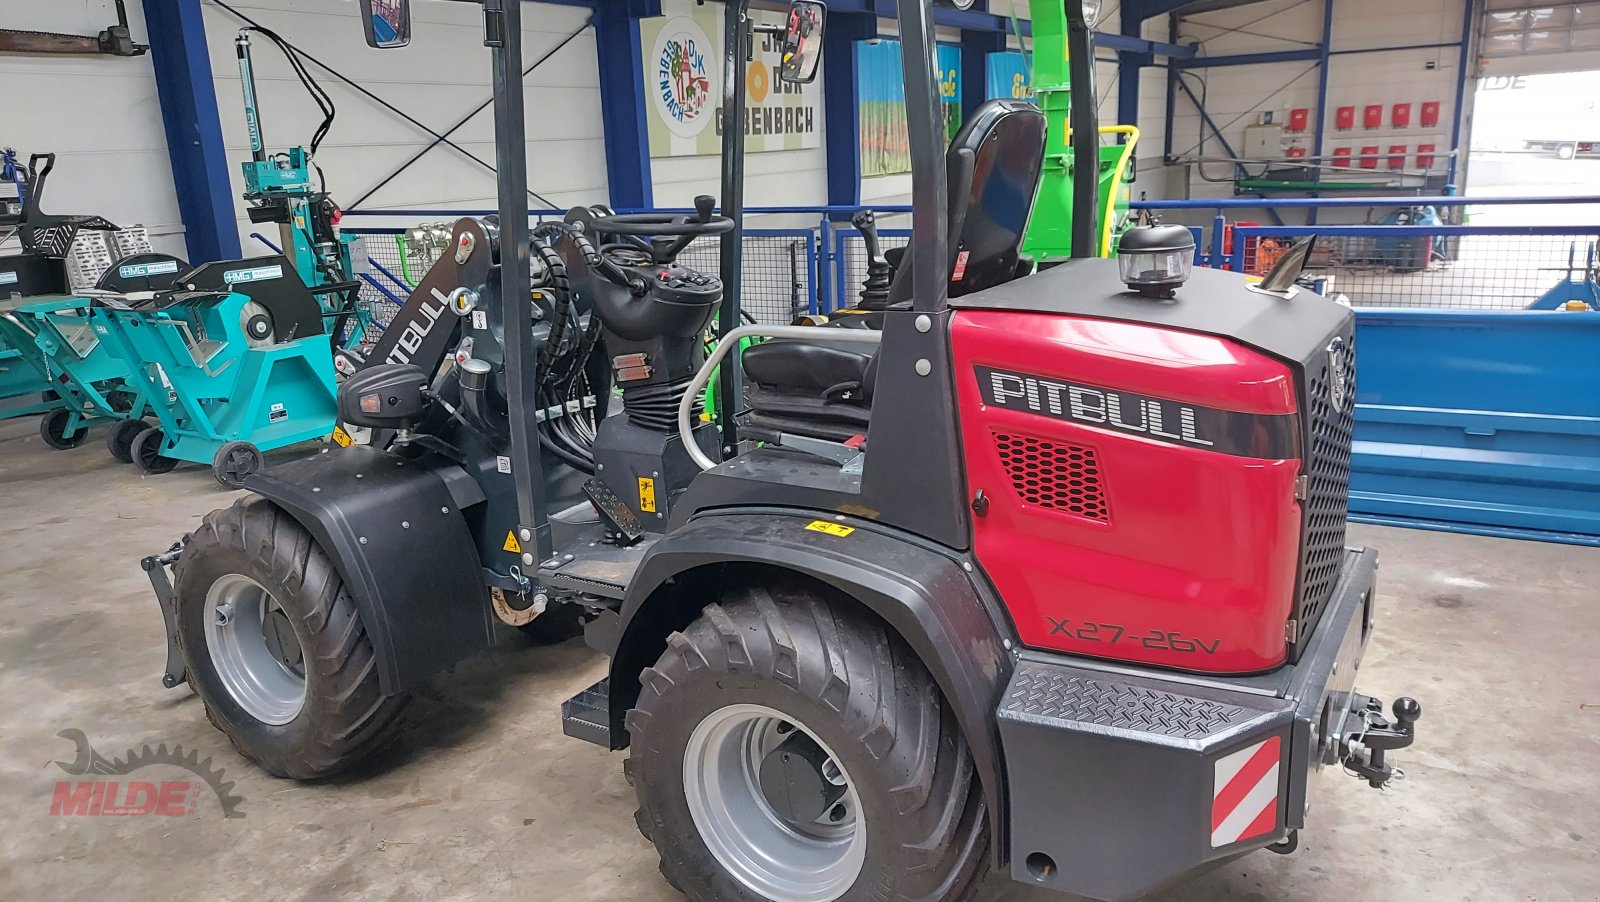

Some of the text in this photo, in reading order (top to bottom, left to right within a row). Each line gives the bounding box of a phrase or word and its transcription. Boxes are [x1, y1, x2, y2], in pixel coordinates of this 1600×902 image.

[688, 39, 706, 75] DJK
[659, 39, 684, 123] GEBENBACH
[715, 106, 813, 136] GBENBACH
[991, 372, 1213, 446] PITBULL
[1045, 616, 1220, 654] X27-26V
